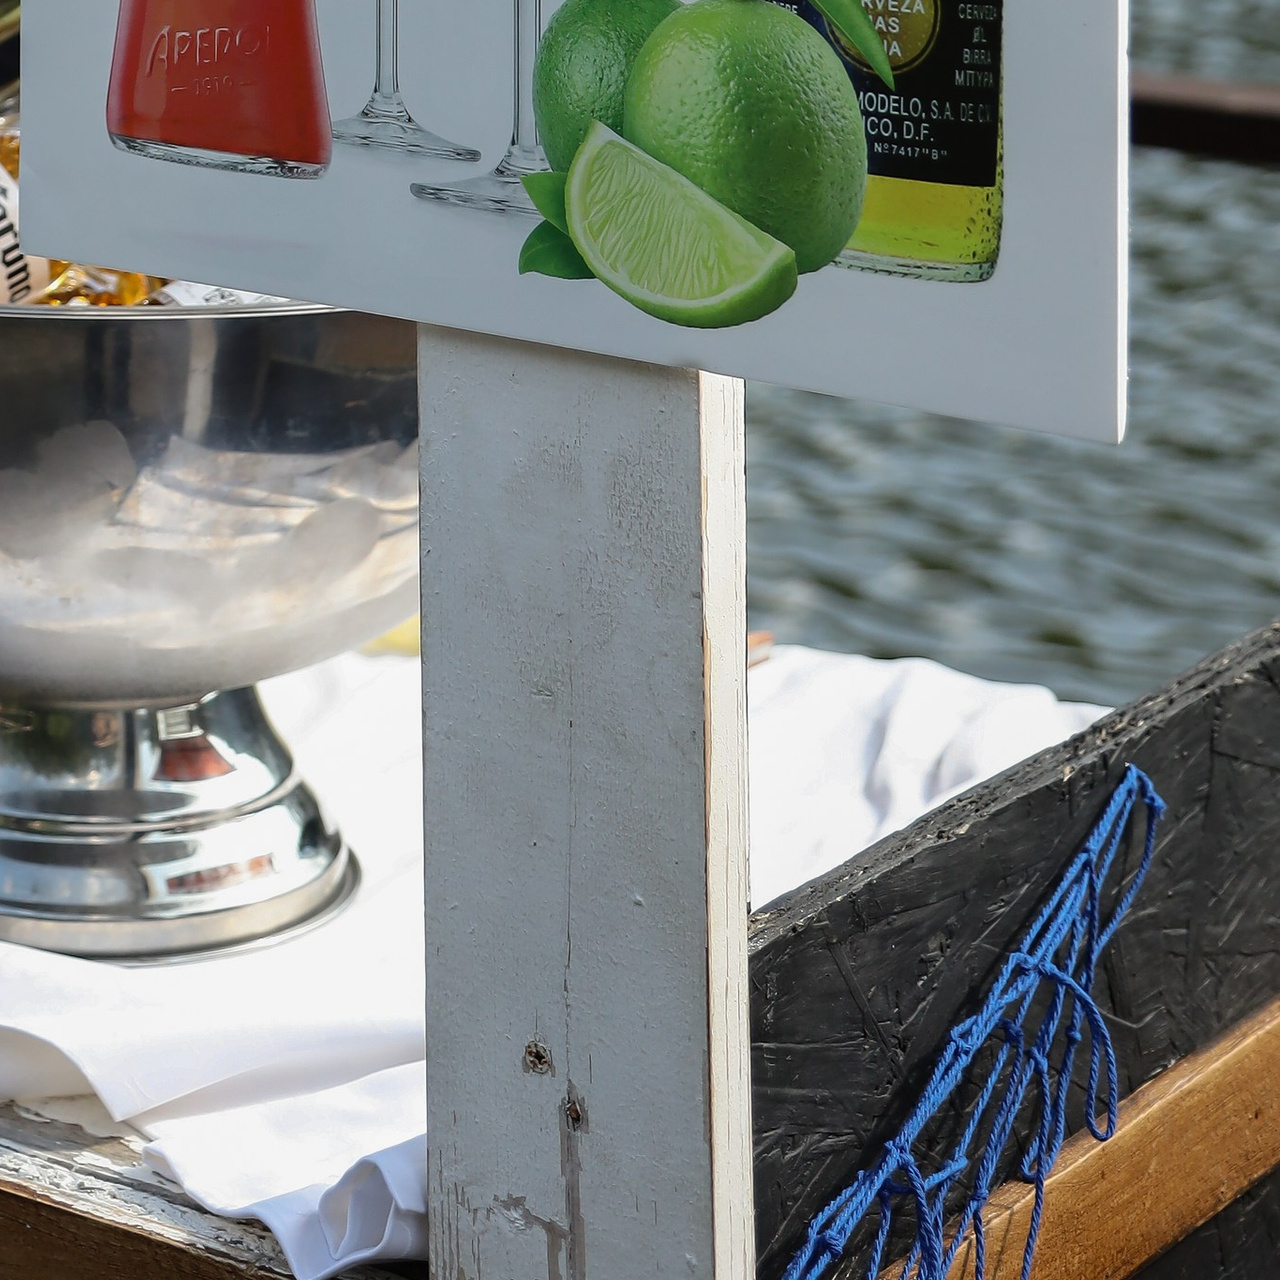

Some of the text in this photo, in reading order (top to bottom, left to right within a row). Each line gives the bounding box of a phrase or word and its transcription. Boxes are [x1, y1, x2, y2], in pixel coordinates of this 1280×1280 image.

[870, 15, 901, 33] AS
[959, 103, 974, 123] DE
[902, 120, 935, 142] D.F.
